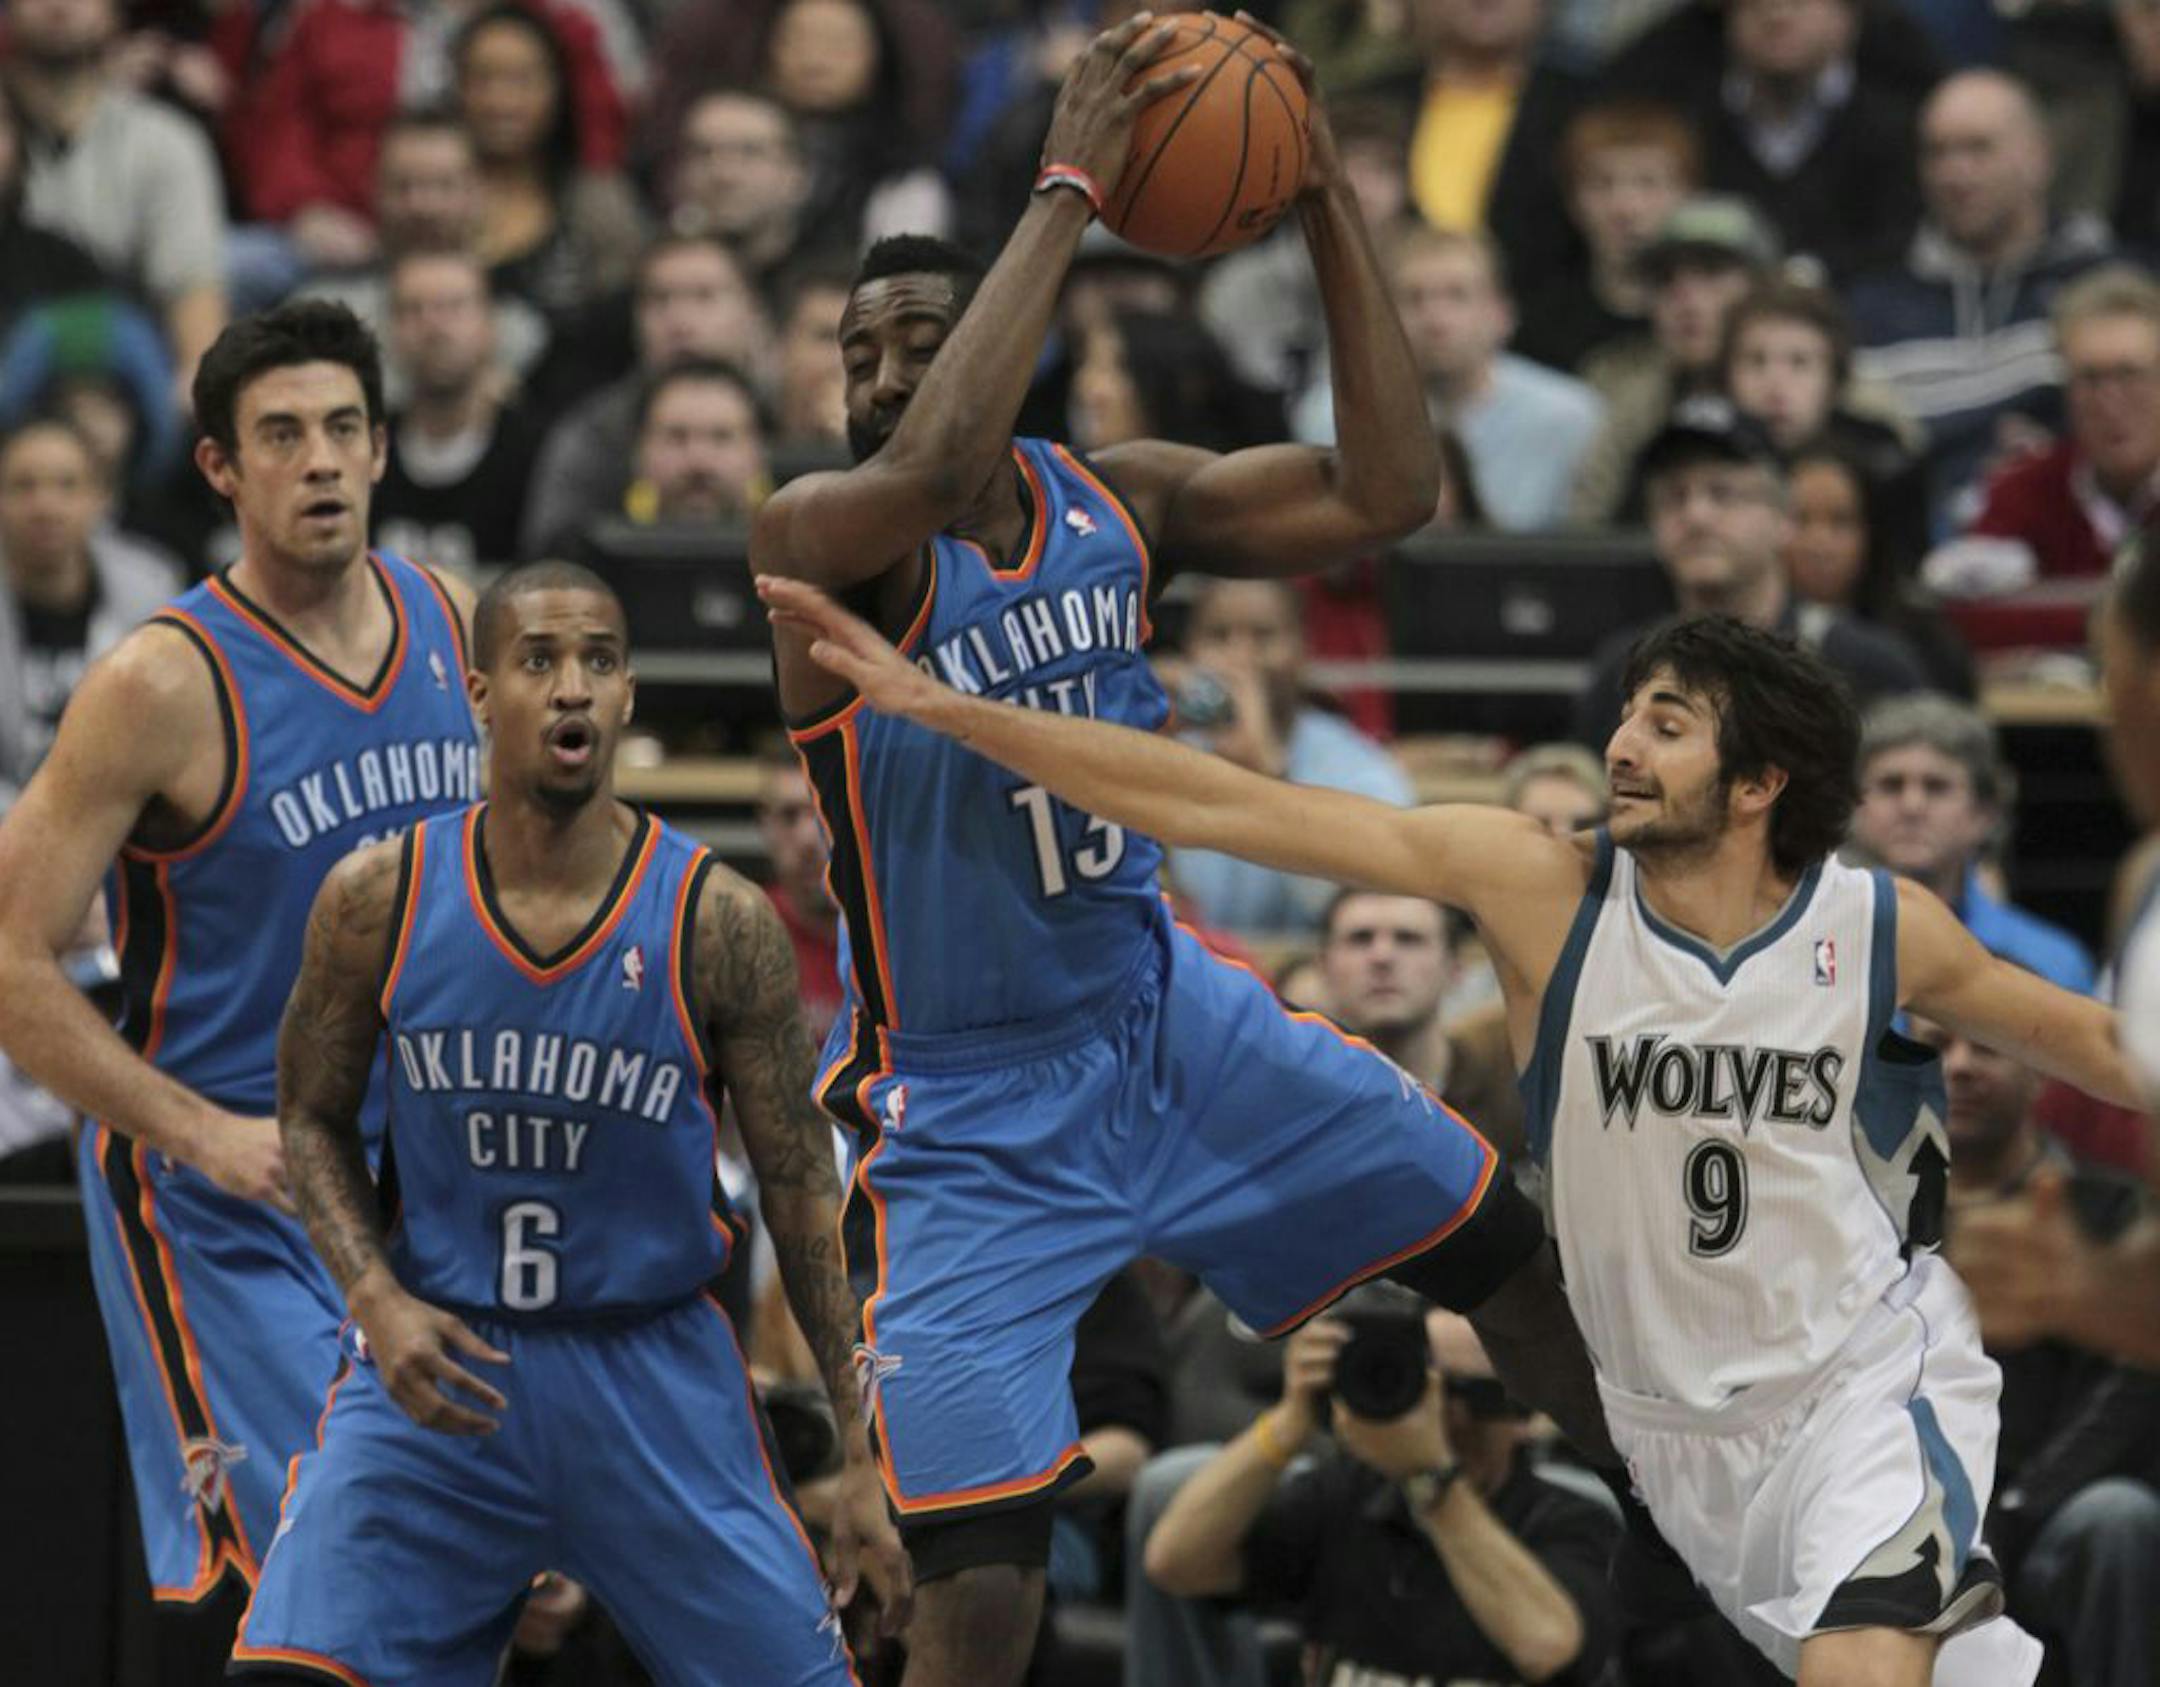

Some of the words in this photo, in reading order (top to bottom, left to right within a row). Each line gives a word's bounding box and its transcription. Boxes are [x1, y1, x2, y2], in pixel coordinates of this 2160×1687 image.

[397, 1029, 681, 1123] OKLAHOMA
[1585, 1034, 1845, 1136] WOLVES
[467, 1111, 589, 1171] CITY
[1683, 1137, 1749, 1259] 9
[501, 1201, 560, 1312] 6
